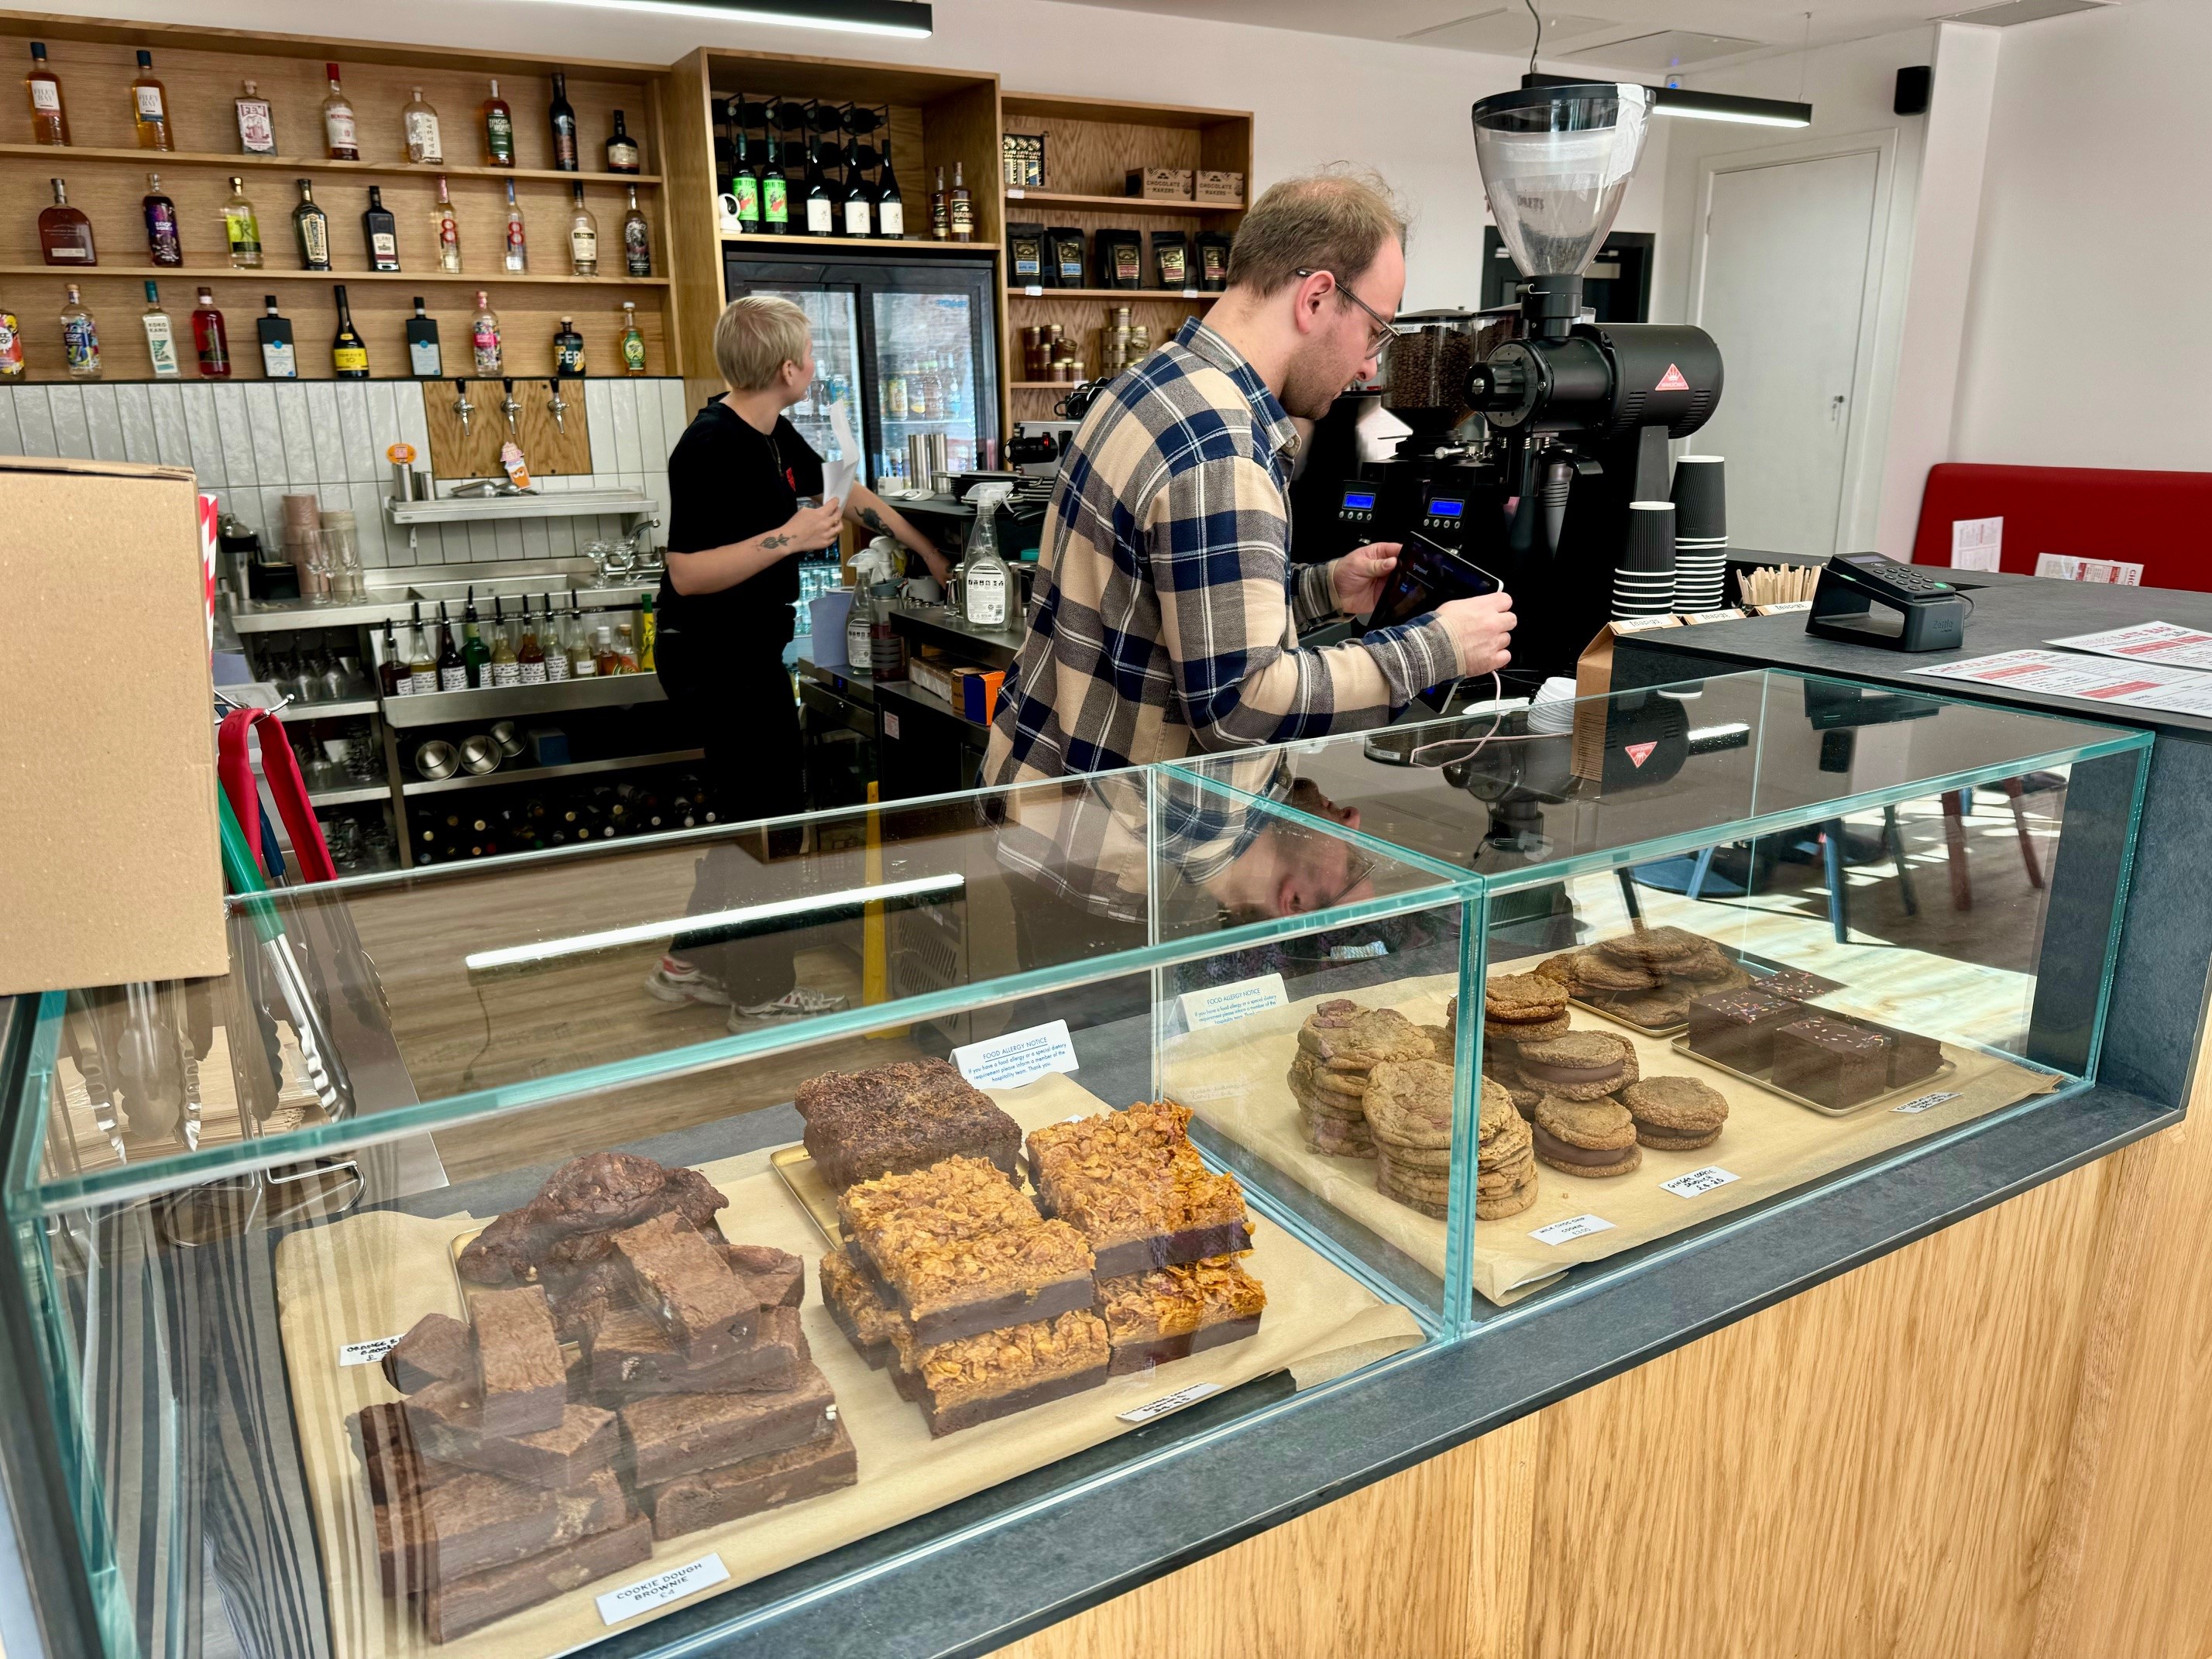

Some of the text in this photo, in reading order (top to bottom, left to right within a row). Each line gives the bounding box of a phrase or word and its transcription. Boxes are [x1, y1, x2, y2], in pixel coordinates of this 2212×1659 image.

[1146, 180, 1180, 188] CHOCOLATE
[1933, 619, 1953, 629] Zettle
[2010, 651, 2042, 660] BAR
[1207, 988, 1261, 1005] FOOD ALLERGY NOTICE
[1251, 996, 1263, 1005] special
[1199, 1013, 1222, 1022] requirement
[1214, 1016, 1234, 1025] hospitality
[983, 1036, 1048, 1060] FOOD ALLERGY NOTICE
[1009, 1055, 1025, 1063] allergy
[1036, 1047, 1051, 1056] special
[974, 1069, 1001, 1080] requirement
[1001, 1065, 1015, 1073] please
[1036, 1054, 1052, 1063] member
[992, 1072, 1014, 1082] hospitality
[1668, 1170, 1716, 1188] GINGER COOKIE
[1561, 1224, 1585, 1233] COOKIE
[346, 1341, 386, 1352] ORANGE
[617, 1562, 703, 1600] COOKIE DOUGH
[634, 1575, 689, 1602] BROWNIE
[659, 1589, 675, 1599] £4
